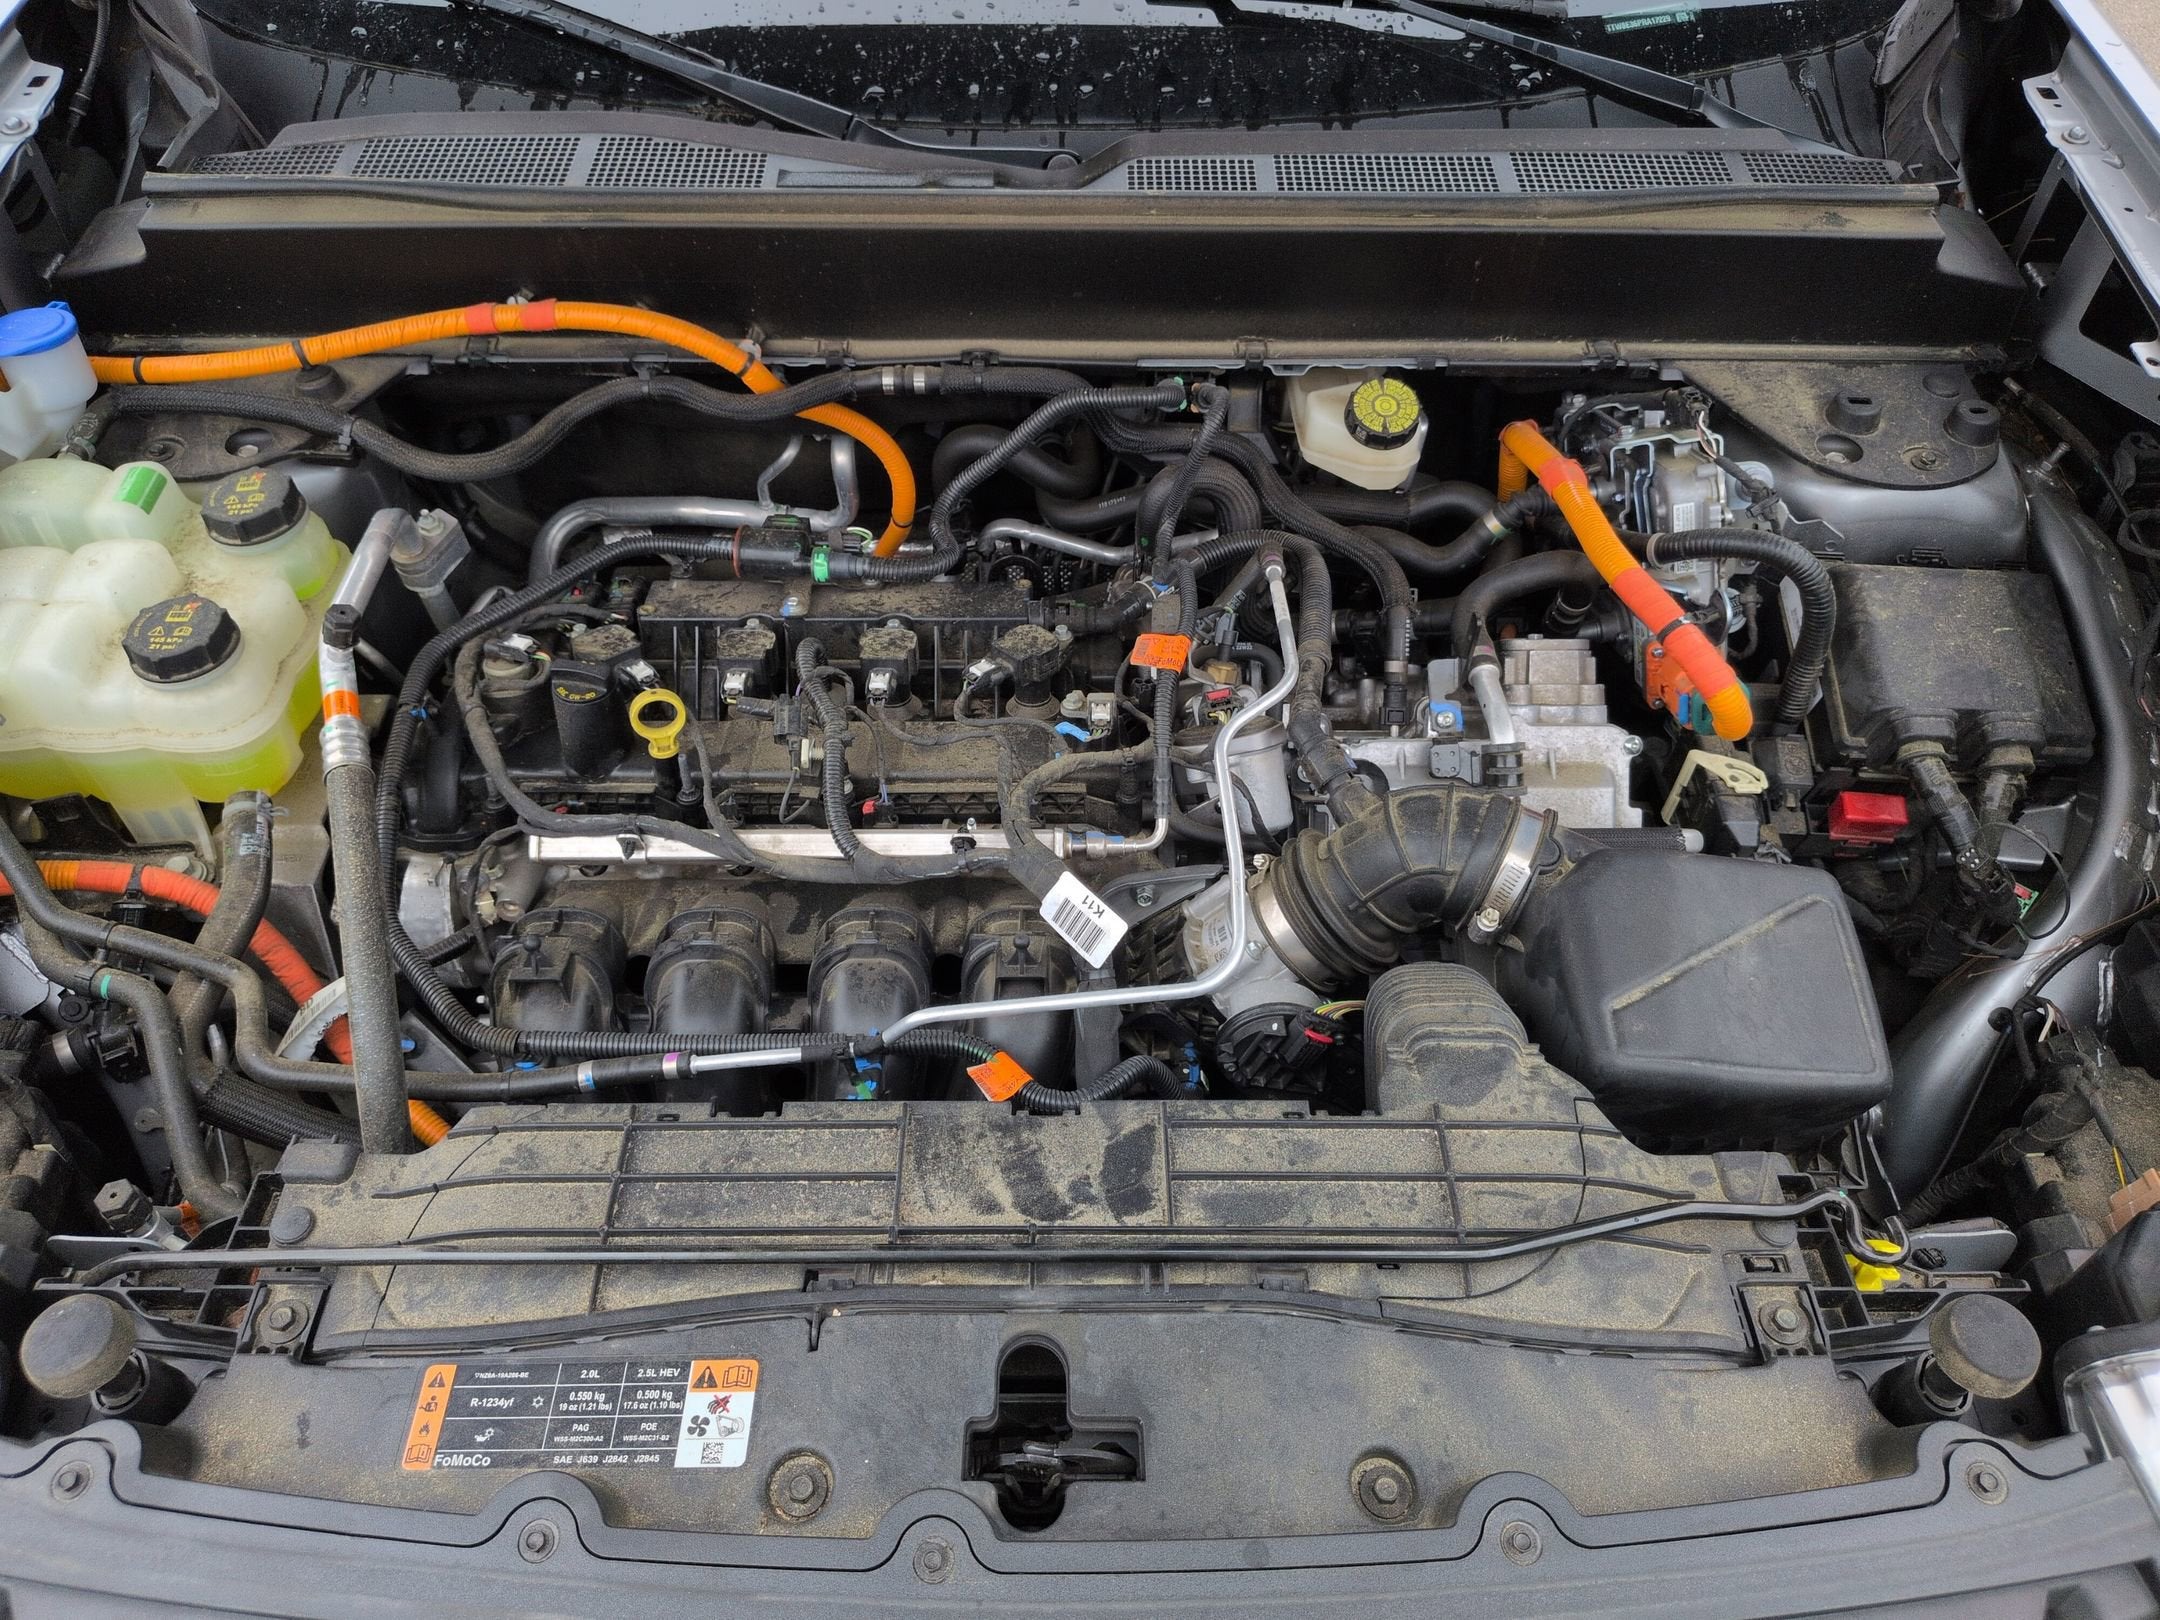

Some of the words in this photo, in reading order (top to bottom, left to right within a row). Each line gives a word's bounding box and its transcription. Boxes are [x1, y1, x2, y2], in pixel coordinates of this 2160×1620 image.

[1081, 894, 1105, 919] K11
[580, 1369, 600, 1378] 2.0L
[637, 1369, 657, 1377] 2.5L
[659, 1368, 680, 1377] HEV
[569, 1391, 593, 1401] 0.550
[594, 1391, 605, 1403] kg
[637, 1390, 660, 1400] 0.500
[661, 1390, 672, 1401] kg
[470, 1397, 515, 1408] R-1234yf
[559, 1403, 567, 1411] 19
[578, 1403, 597, 1412] (1.21
[597, 1402, 612, 1412] lbs)
[623, 1402, 638, 1410] 17.6
[668, 1401, 683, 1410] lbs)
[572, 1423, 589, 1431] PAG
[640, 1422, 658, 1431] POE
[433, 1454, 491, 1467] FoMoCo
[553, 1455, 573, 1464] SAE
[577, 1455, 599, 1463] J639
[602, 1455, 628, 1463] J2842
[634, 1454, 660, 1463] J2845
